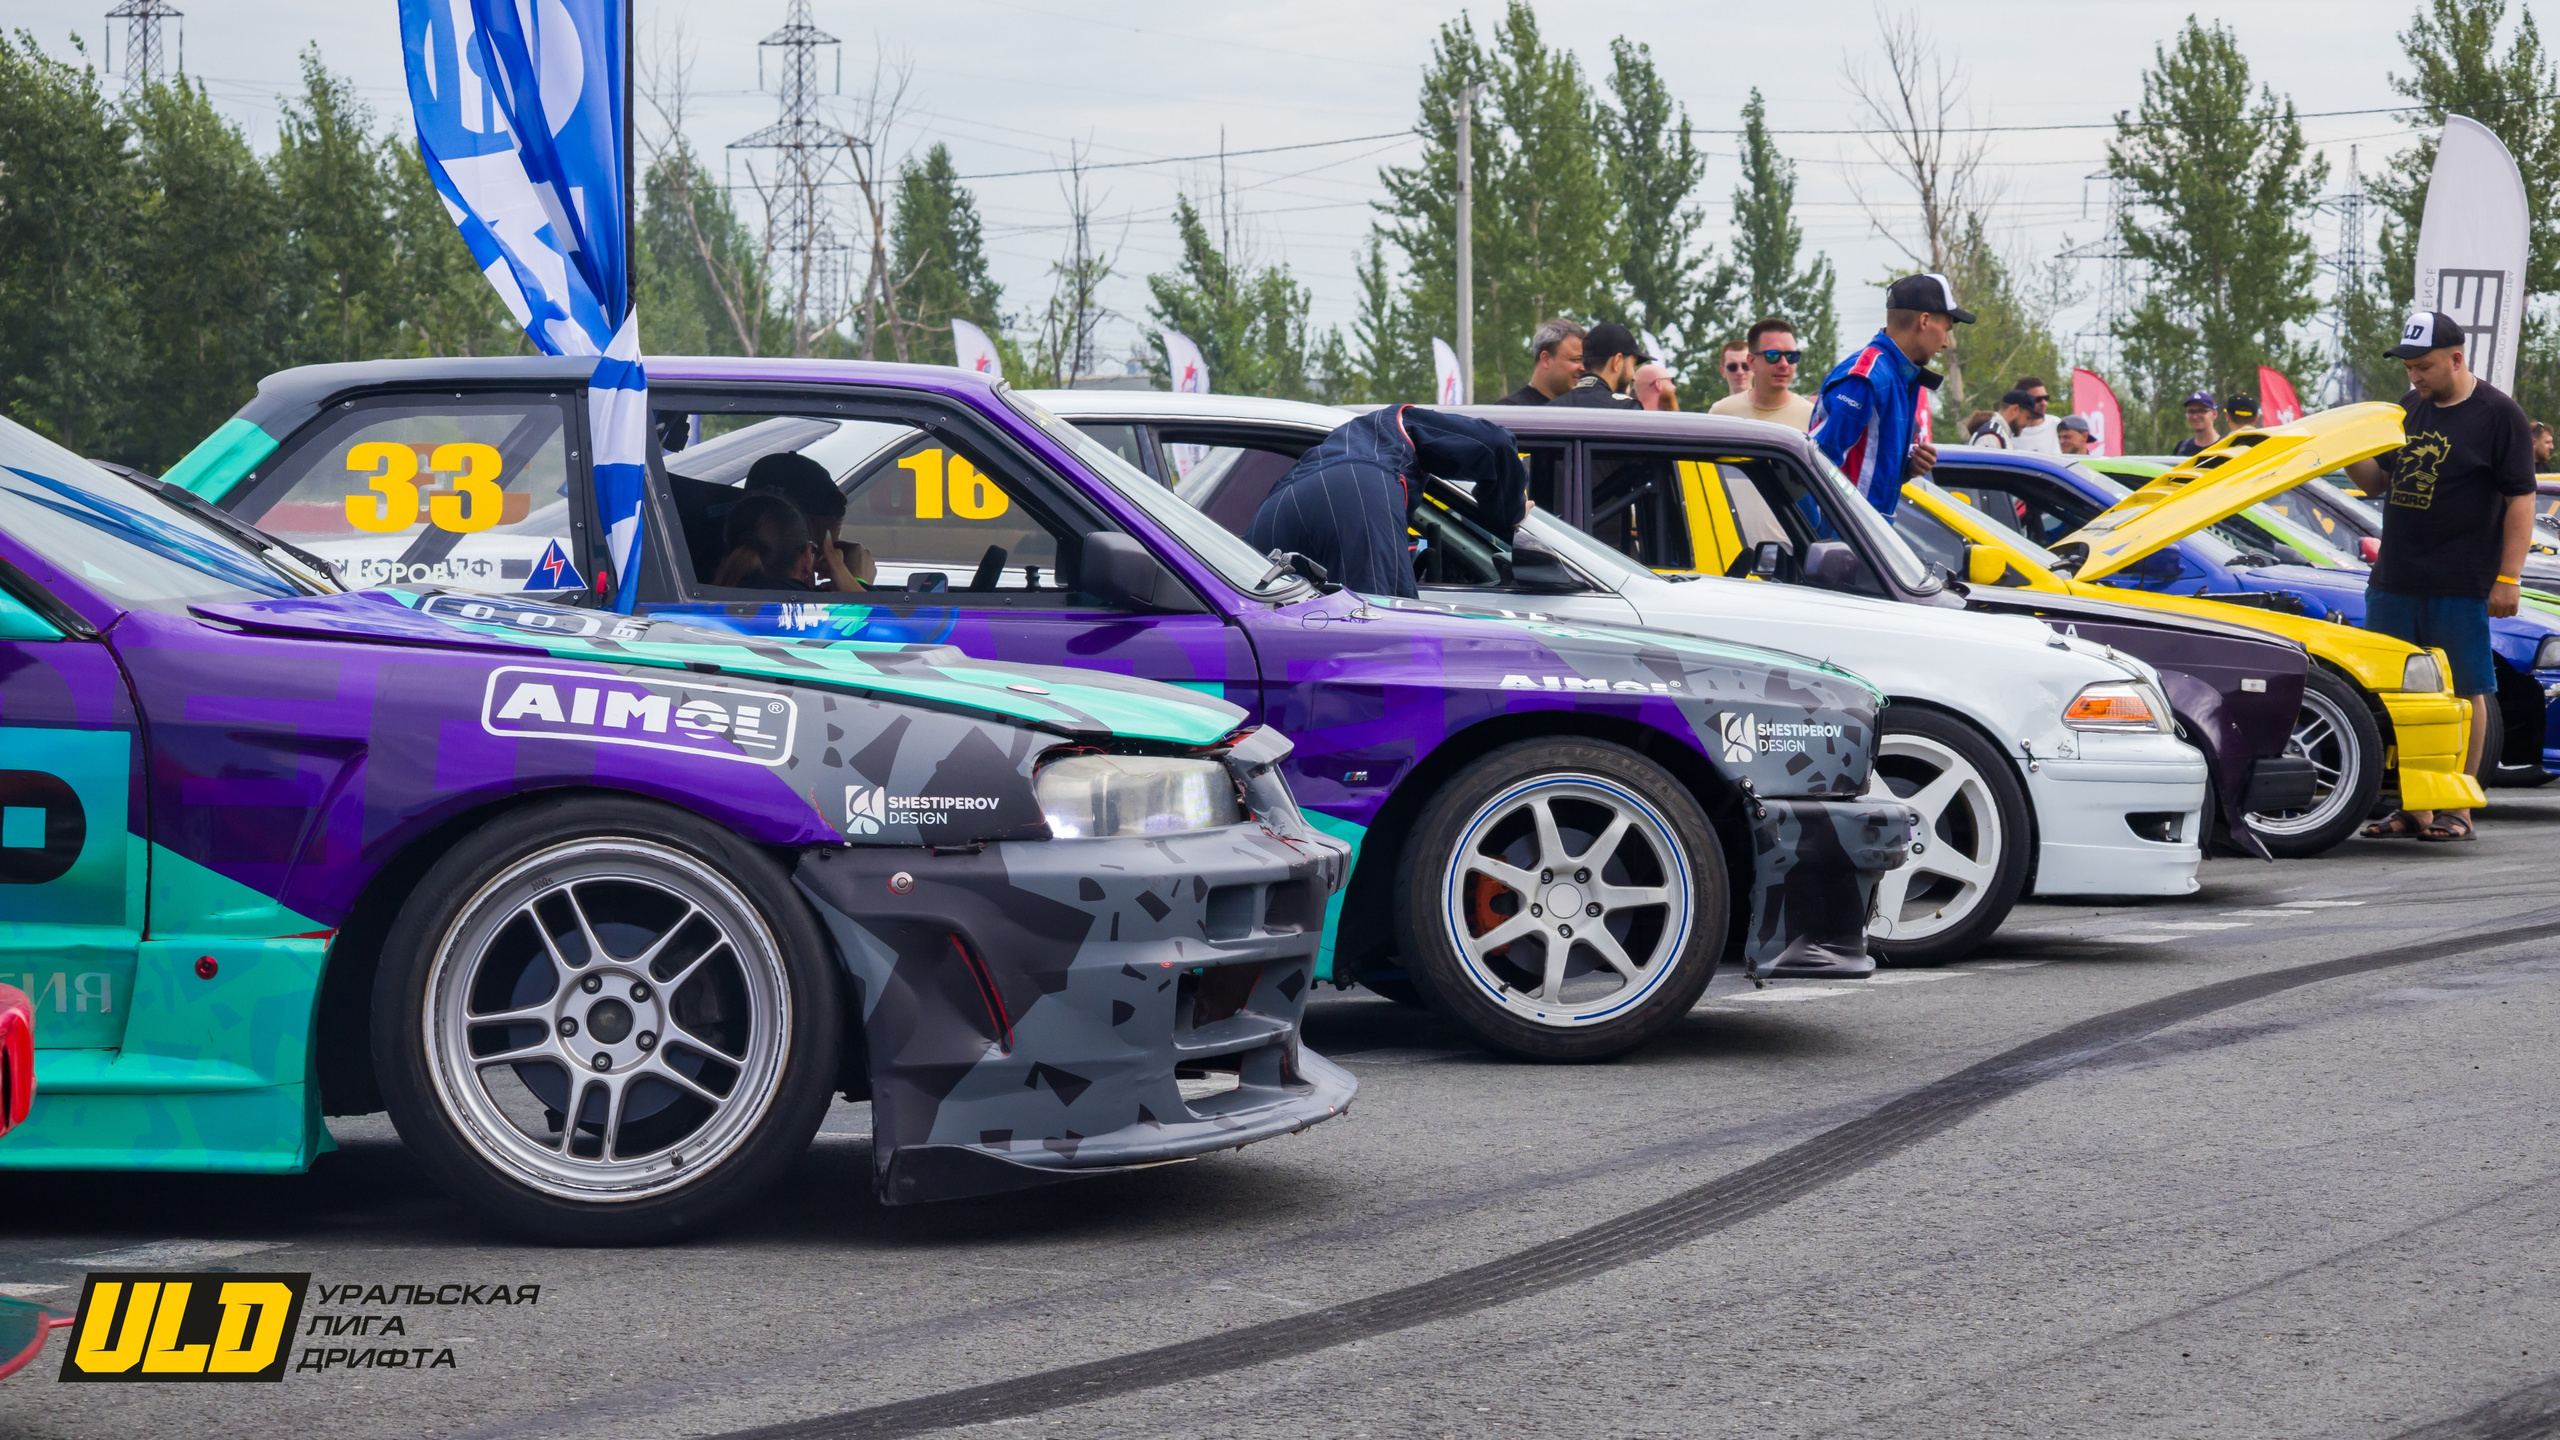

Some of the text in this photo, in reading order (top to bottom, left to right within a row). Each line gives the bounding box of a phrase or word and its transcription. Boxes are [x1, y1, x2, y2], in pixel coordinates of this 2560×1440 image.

[345, 441, 504, 534] 33
[897, 448, 1009, 520] 16
[1757, 723, 1843, 738] SHESTIPEROV
[1760, 739, 1806, 752] DESIGN
[888, 796, 1000, 811] SHESTIPEROV
[889, 811, 948, 825] DESIGN
